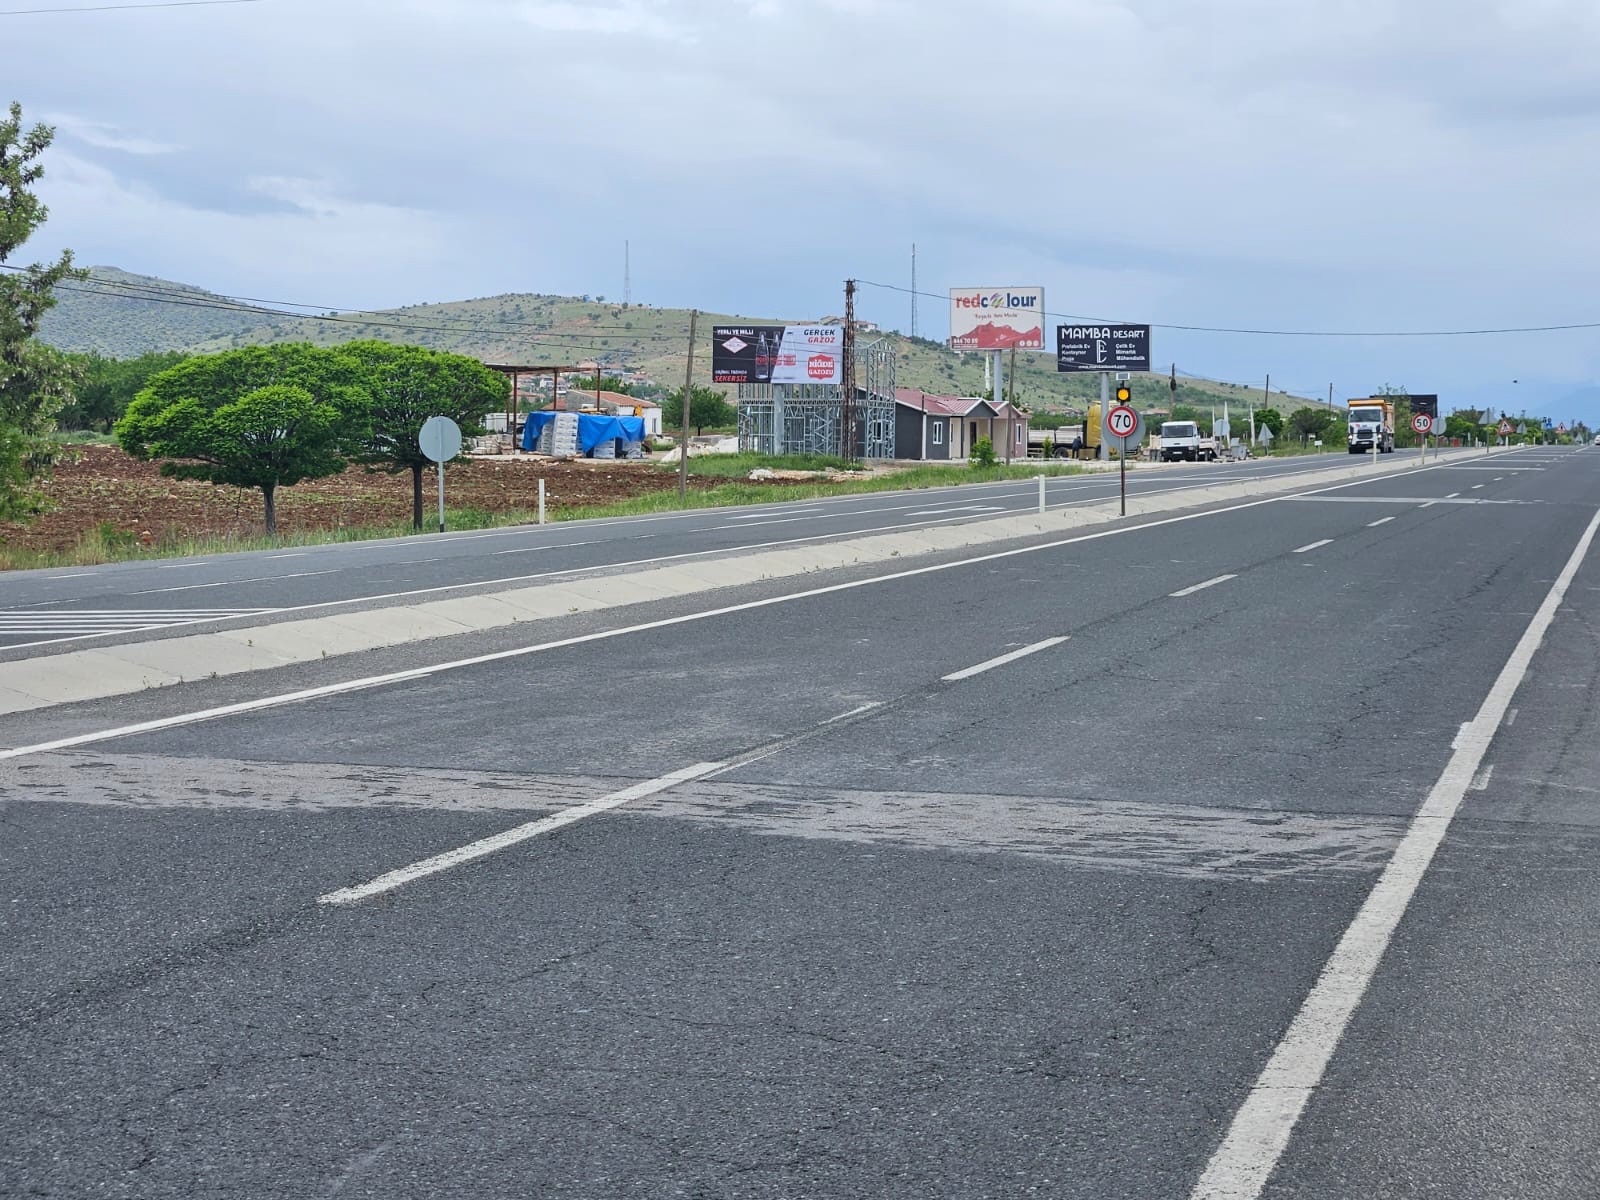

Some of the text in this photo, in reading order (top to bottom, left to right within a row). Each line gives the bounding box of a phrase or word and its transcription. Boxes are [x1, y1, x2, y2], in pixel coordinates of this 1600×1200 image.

[1061, 327, 1145, 339] MAMBA DESART
[1114, 414, 1131, 428] 70
[1416, 418, 1429, 428] 50
